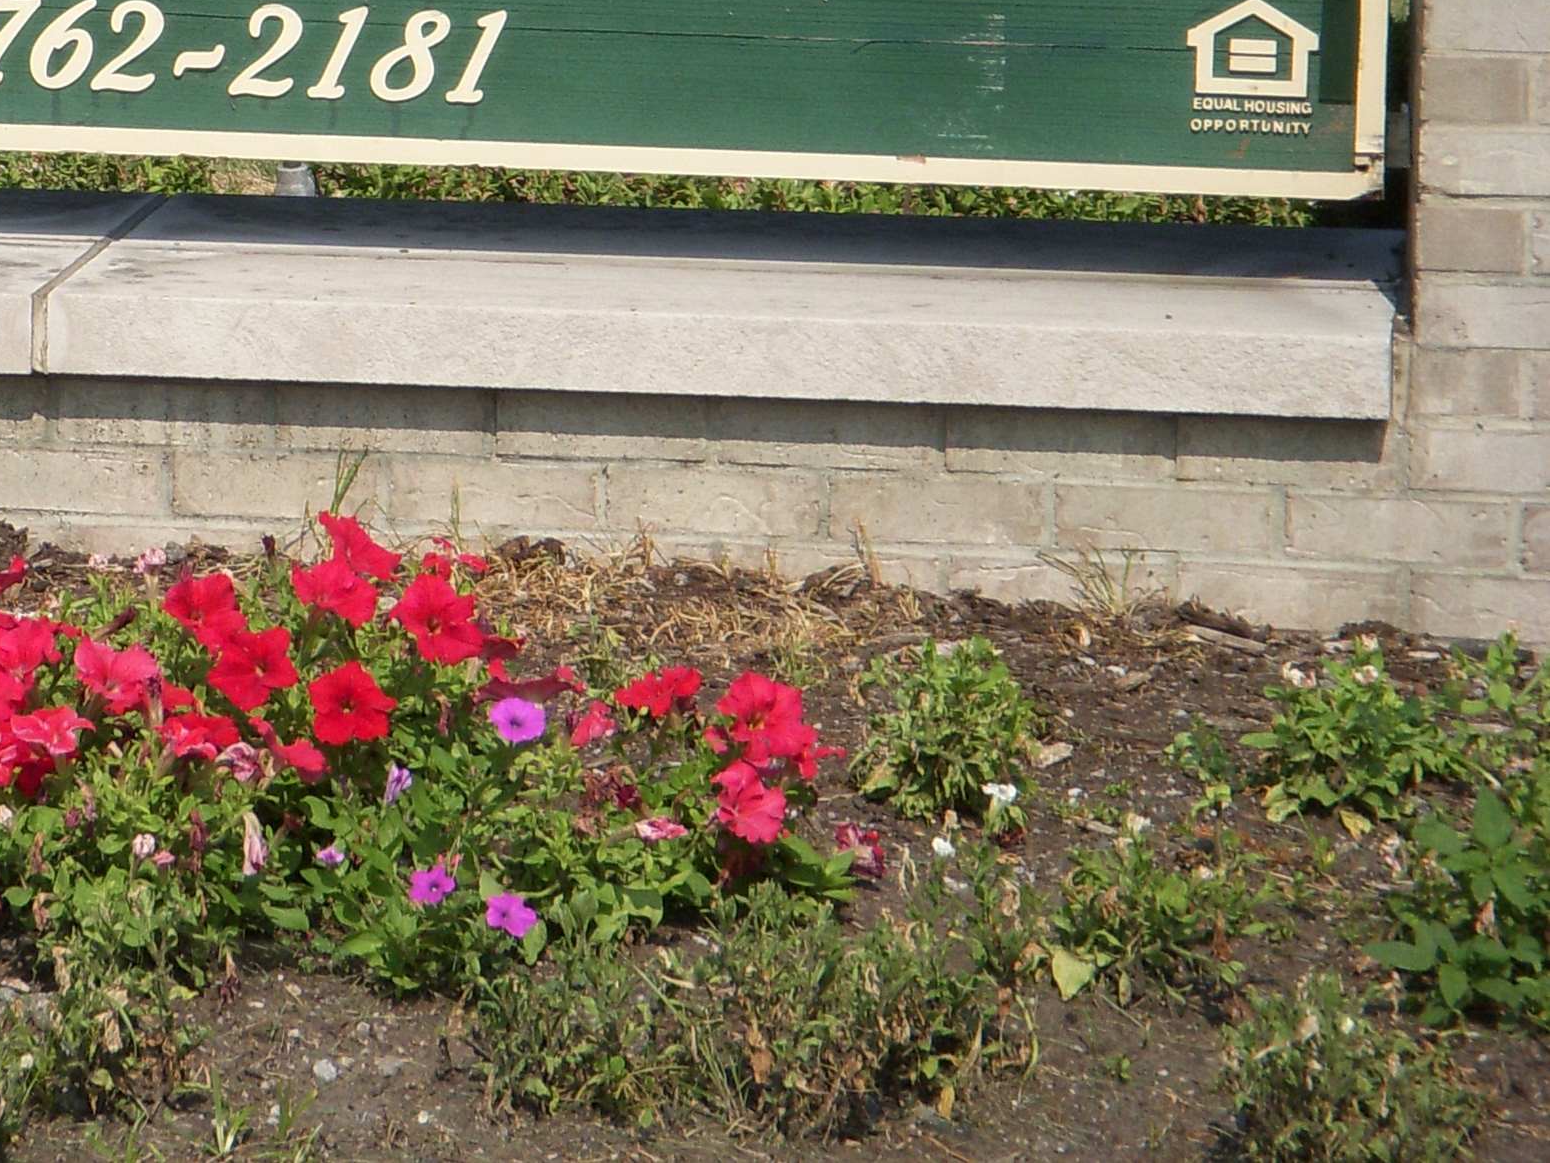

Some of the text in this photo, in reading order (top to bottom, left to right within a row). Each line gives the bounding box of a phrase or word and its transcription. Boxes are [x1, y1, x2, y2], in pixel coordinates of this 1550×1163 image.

[1193, 97, 1312, 114] EQUAL HOUSING
[1190, 118, 1311, 135] OPPORTUNITY
